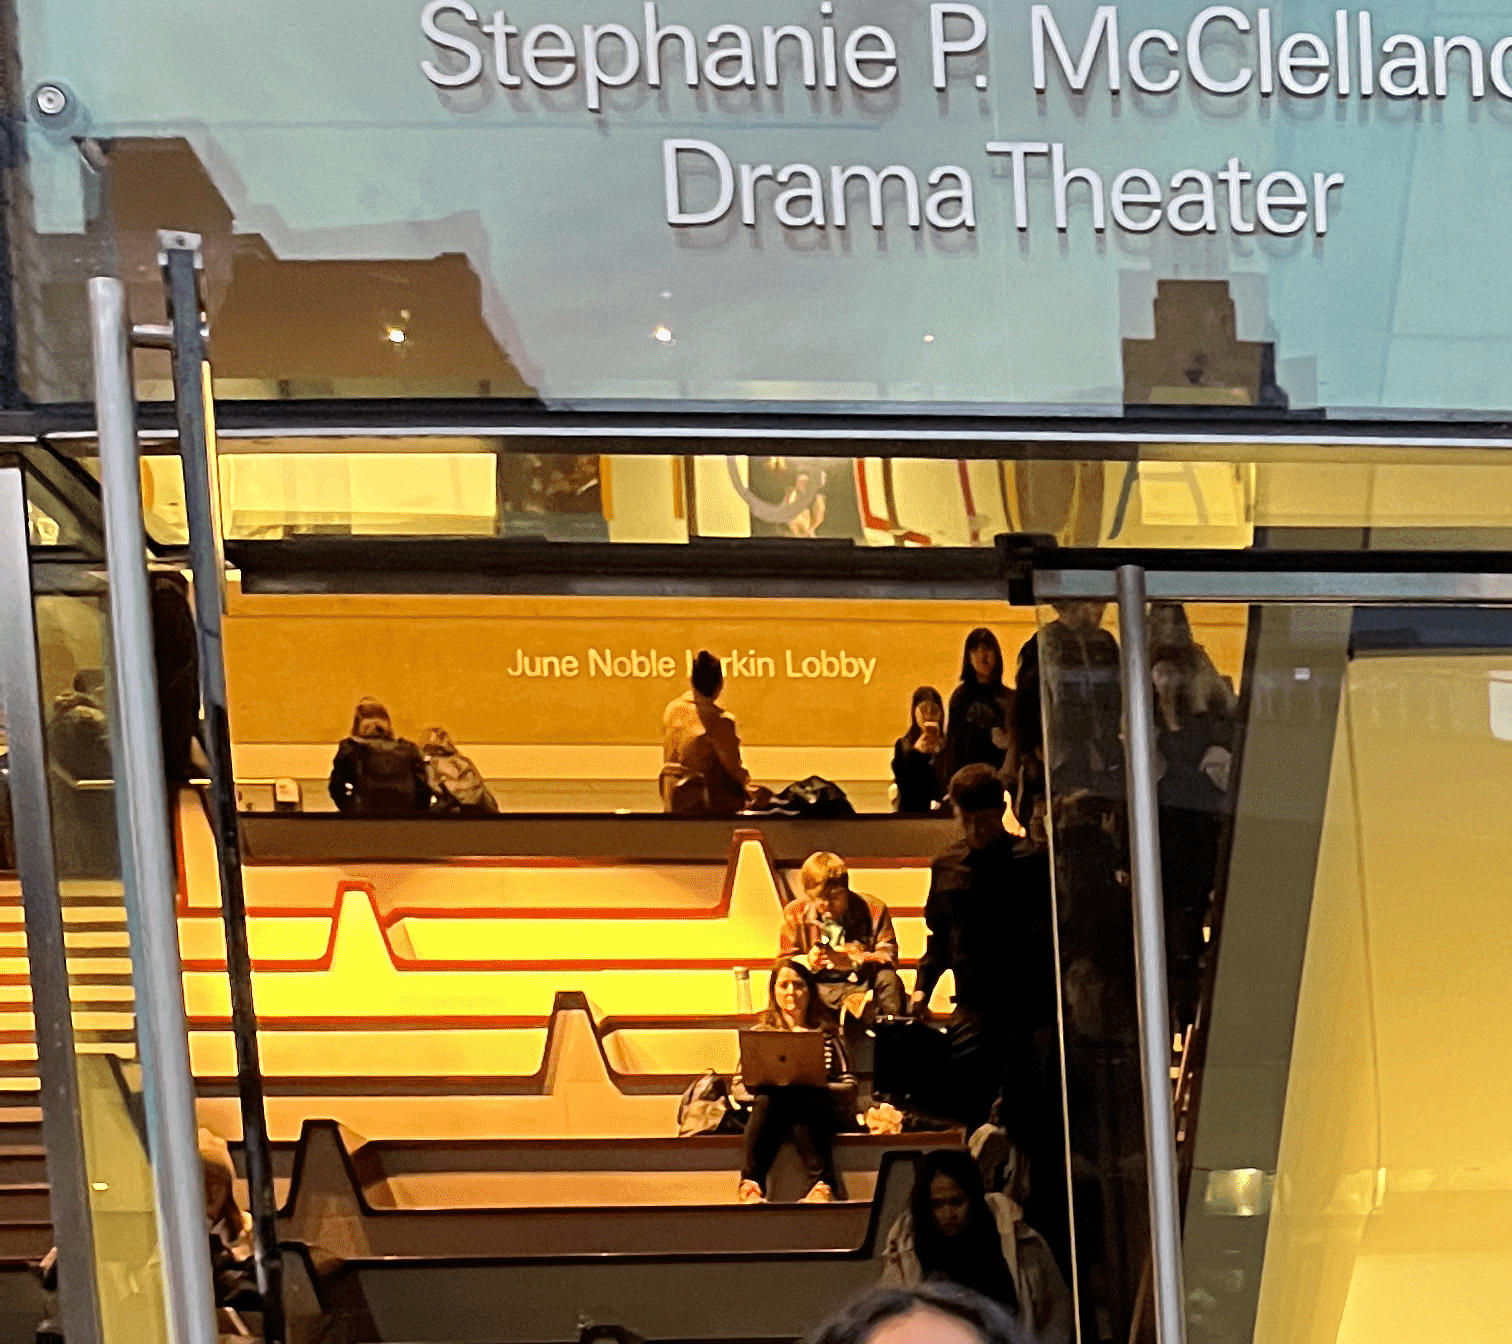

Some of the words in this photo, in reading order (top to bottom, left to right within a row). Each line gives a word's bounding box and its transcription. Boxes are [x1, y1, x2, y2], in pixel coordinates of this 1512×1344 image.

[420, 0, 898, 112] Stephanie
[930, 3, 988, 88] P.
[662, 138, 976, 230] Drama
[986, 141, 1345, 236] Theater
[507, 648, 579, 677] June
[588, 648, 676, 677] Noble
[686, 649, 775, 677] Lrkin
[786, 649, 876, 684] Lobby
